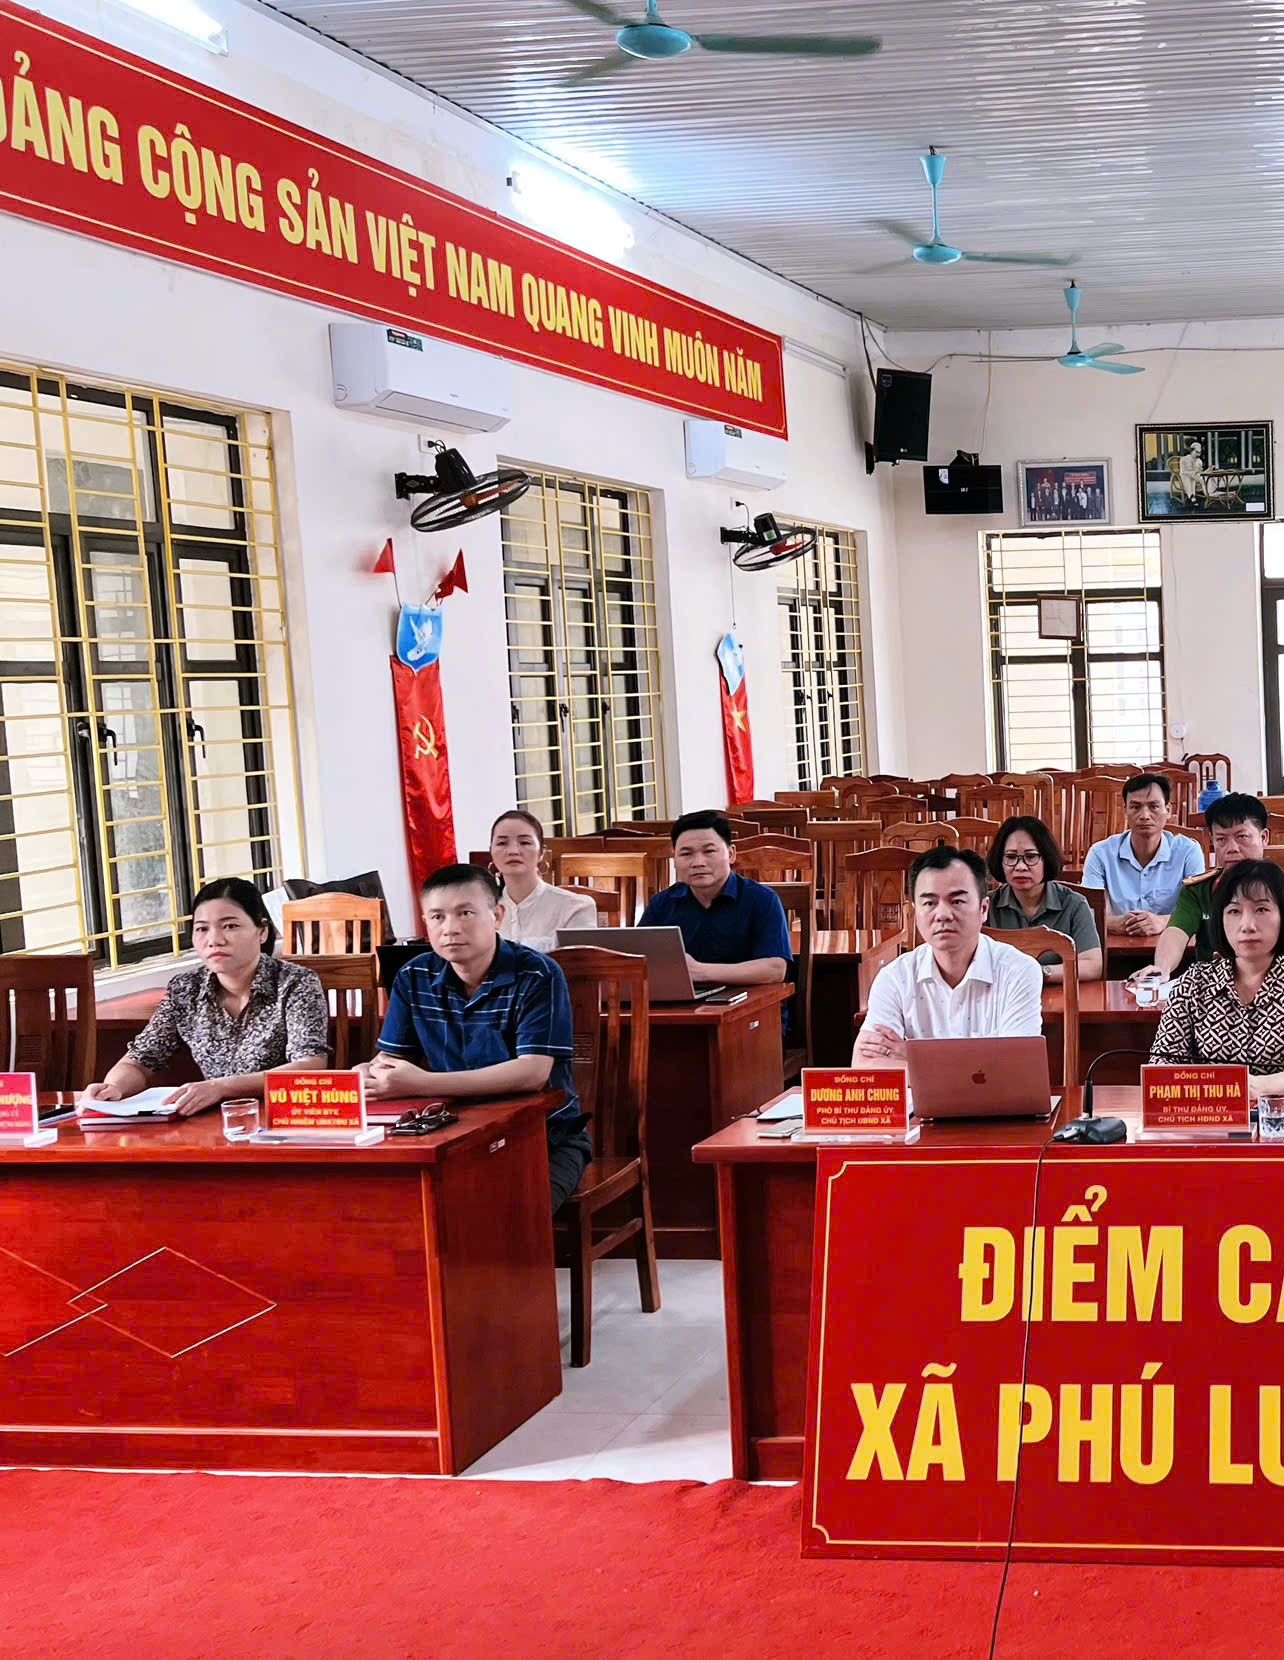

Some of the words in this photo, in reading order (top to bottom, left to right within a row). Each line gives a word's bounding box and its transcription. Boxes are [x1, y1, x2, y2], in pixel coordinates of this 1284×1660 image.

[0, 50, 124, 185] ẢNG
[137, 123, 265, 233] CỘNG
[276, 167, 359, 265] SẢN
[365, 212, 437, 297] VIỆT
[445, 242, 516, 318] NAM
[521, 272, 604, 348] QUANG
[608, 304, 660, 367] VINH
[663, 331, 721, 388] MUÔN
[722, 345, 764, 402] NĂM
[834, 1074, 858, 1083] ĐỒNG
[860, 1074, 875, 1083] CHÍ
[1174, 1070, 1198, 1079] ĐỒNG
[269, 1087, 287, 1103] VŨ
[289, 1087, 318, 1106] VIỆT
[321, 1087, 359, 1103] HÙNG
[810, 1087, 843, 1102] DƯƠNG
[844, 1088, 865, 1101] ANH
[867, 1088, 900, 1102] CHUNG
[1149, 1084, 1181, 1101] PHẠM
[1183, 1084, 1201, 1101] THỊ
[1203, 1084, 1224, 1098] THU
[1226, 1081, 1241, 1098] HÀ
[816, 1105, 833, 1114] PHÓ
[834, 1106, 842, 1114] BÍ
[843, 1106, 859, 1114] THƯ
[860, 1105, 881, 1114] ĐẢNG
[1173, 1105, 1190, 1113] THƯ
[1191, 1104, 1213, 1113] ĐẢNG
[821, 1116, 837, 1125] CHỦ
[839, 1117, 856, 1126] TỊCH
[858, 1117, 879, 1125] UBND
[880, 1116, 891, 1124] XÃ
[1158, 1114, 1175, 1122] CHỦ
[1178, 1115, 1195, 1123] TỊCH
[1222, 1114, 1233, 1122] XÃ
[958, 1184, 1184, 1323] ĐIỂM
[846, 1362, 966, 1481] XÃ
[996, 1361, 1174, 1484] PHÚ
